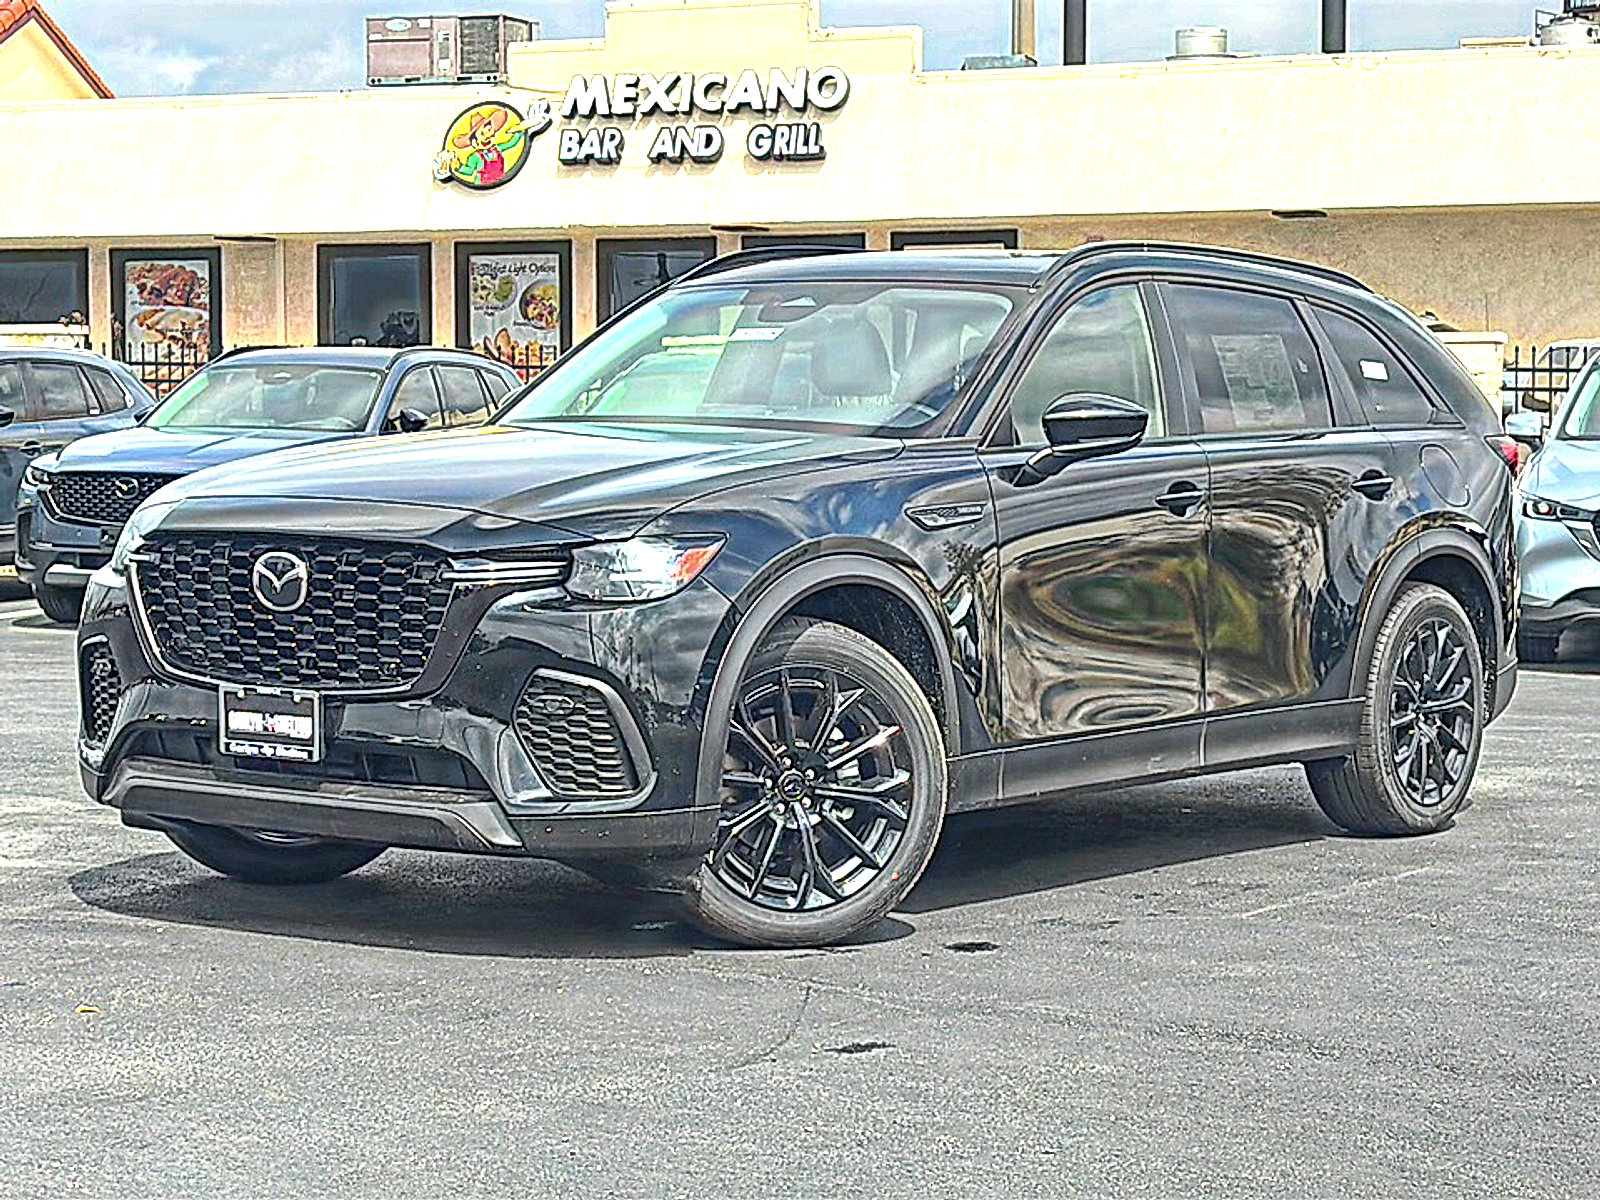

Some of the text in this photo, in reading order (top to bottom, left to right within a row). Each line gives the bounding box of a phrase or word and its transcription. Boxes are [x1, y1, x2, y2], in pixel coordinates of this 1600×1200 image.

[561, 67, 849, 118] MEXICANO
[559, 123, 823, 162] BAR AND GRILL
